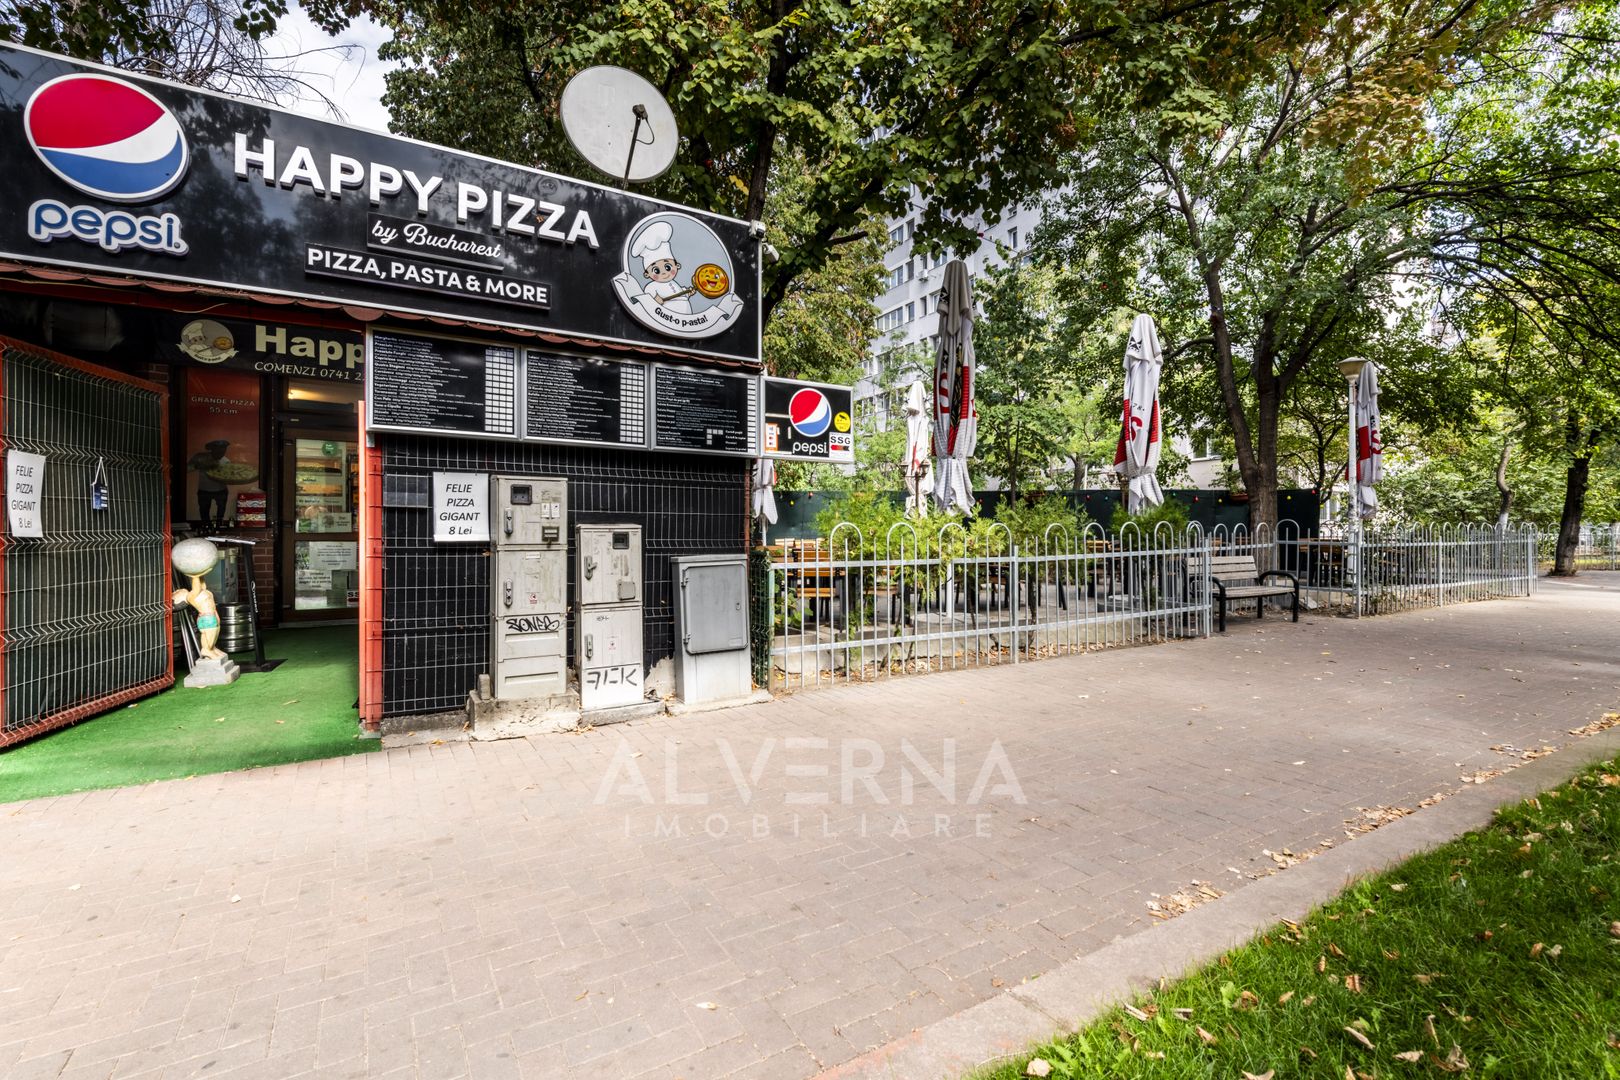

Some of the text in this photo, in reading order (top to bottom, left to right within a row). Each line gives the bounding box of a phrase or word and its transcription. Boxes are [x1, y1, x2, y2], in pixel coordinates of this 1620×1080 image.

[235, 132, 600, 249] HAPPY PIZZA
[31, 200, 182, 249] pepsi
[371, 219, 502, 259] by Bucharest
[307, 247, 548, 304] PIZZA, PASTA & MORE
[654, 307, 709, 328] Gust-o p-asta!
[254, 361, 316, 378] COMENZI
[320, 368, 349, 380] 0741
[230, 398, 255, 407] PIZZA
[830, 435, 851, 445] SSG
[792, 441, 828, 456] pepsi
[16, 465, 34, 477] FELIE
[16, 482, 33, 495] PIZZA
[445, 483, 473, 493] FELIE
[11, 499, 36, 511] GIGANT
[446, 498, 475, 507] PIZZA
[439, 511, 481, 521] GIGANT
[24, 518, 33, 528] Lei
[448, 526, 473, 535] 8 Lei
